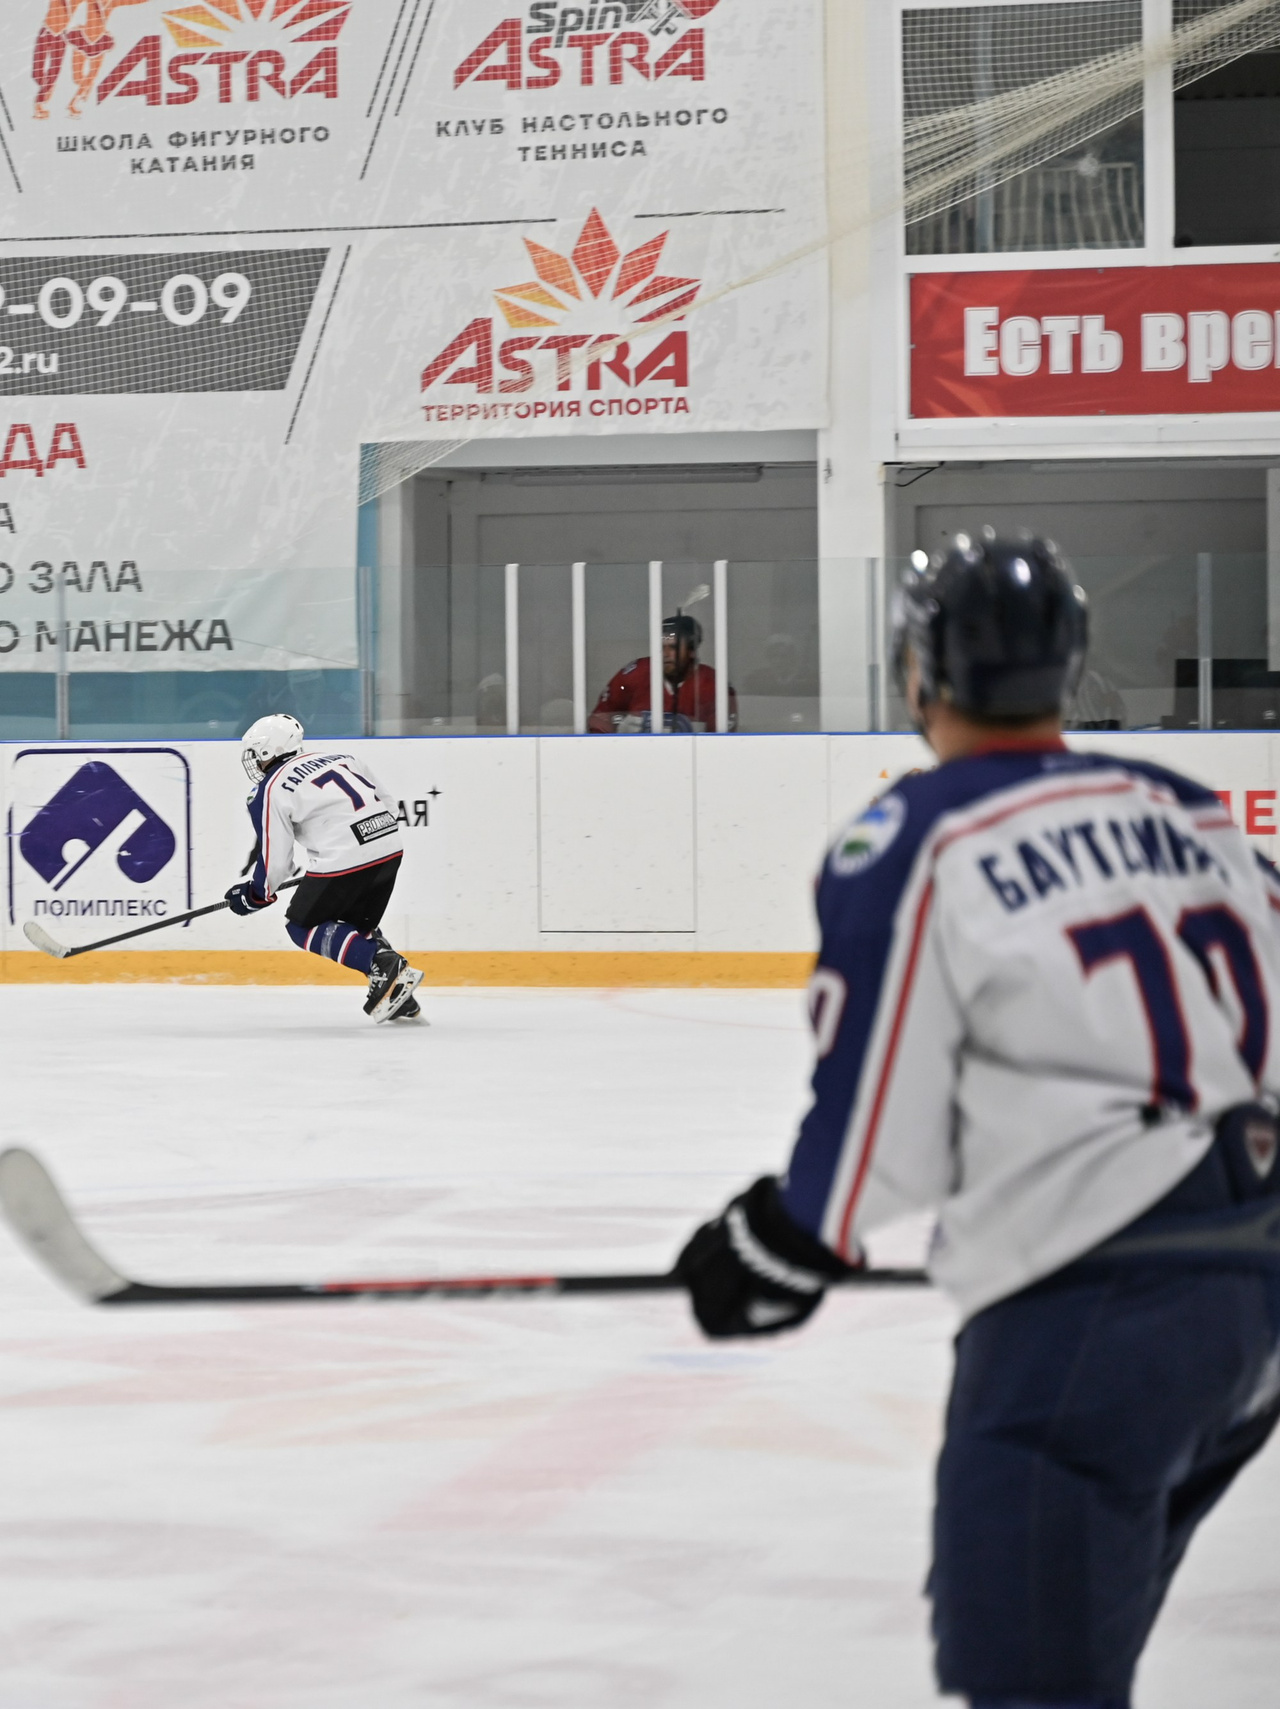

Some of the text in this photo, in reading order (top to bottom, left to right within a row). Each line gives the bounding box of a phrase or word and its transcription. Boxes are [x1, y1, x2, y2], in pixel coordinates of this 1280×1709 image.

[525, 0, 621, 48] Spin
[96, 35, 339, 106] ASTRA
[453, 18, 706, 91] ASTRA
[56, 126, 331, 153] ШКОЛА ФИГУРНОГО
[435, 107, 728, 137] КЛУБ НАСТОЛЬНОГО
[130, 154, 256, 175] КАТАНИЯ
[517, 140, 648, 162] ТЕННИСА
[420, 317, 689, 394] ASTRA
[963, 306, 1280, 383] Есть вре
[420, 397, 690, 422] ТЕРРИТОРИЯ СПОРТА
[27, 560, 144, 595] ЗАЛА
[34, 618, 235, 653] МАНЕЖА
[33, 899, 168, 917] ПОЛИПЛЕКС
